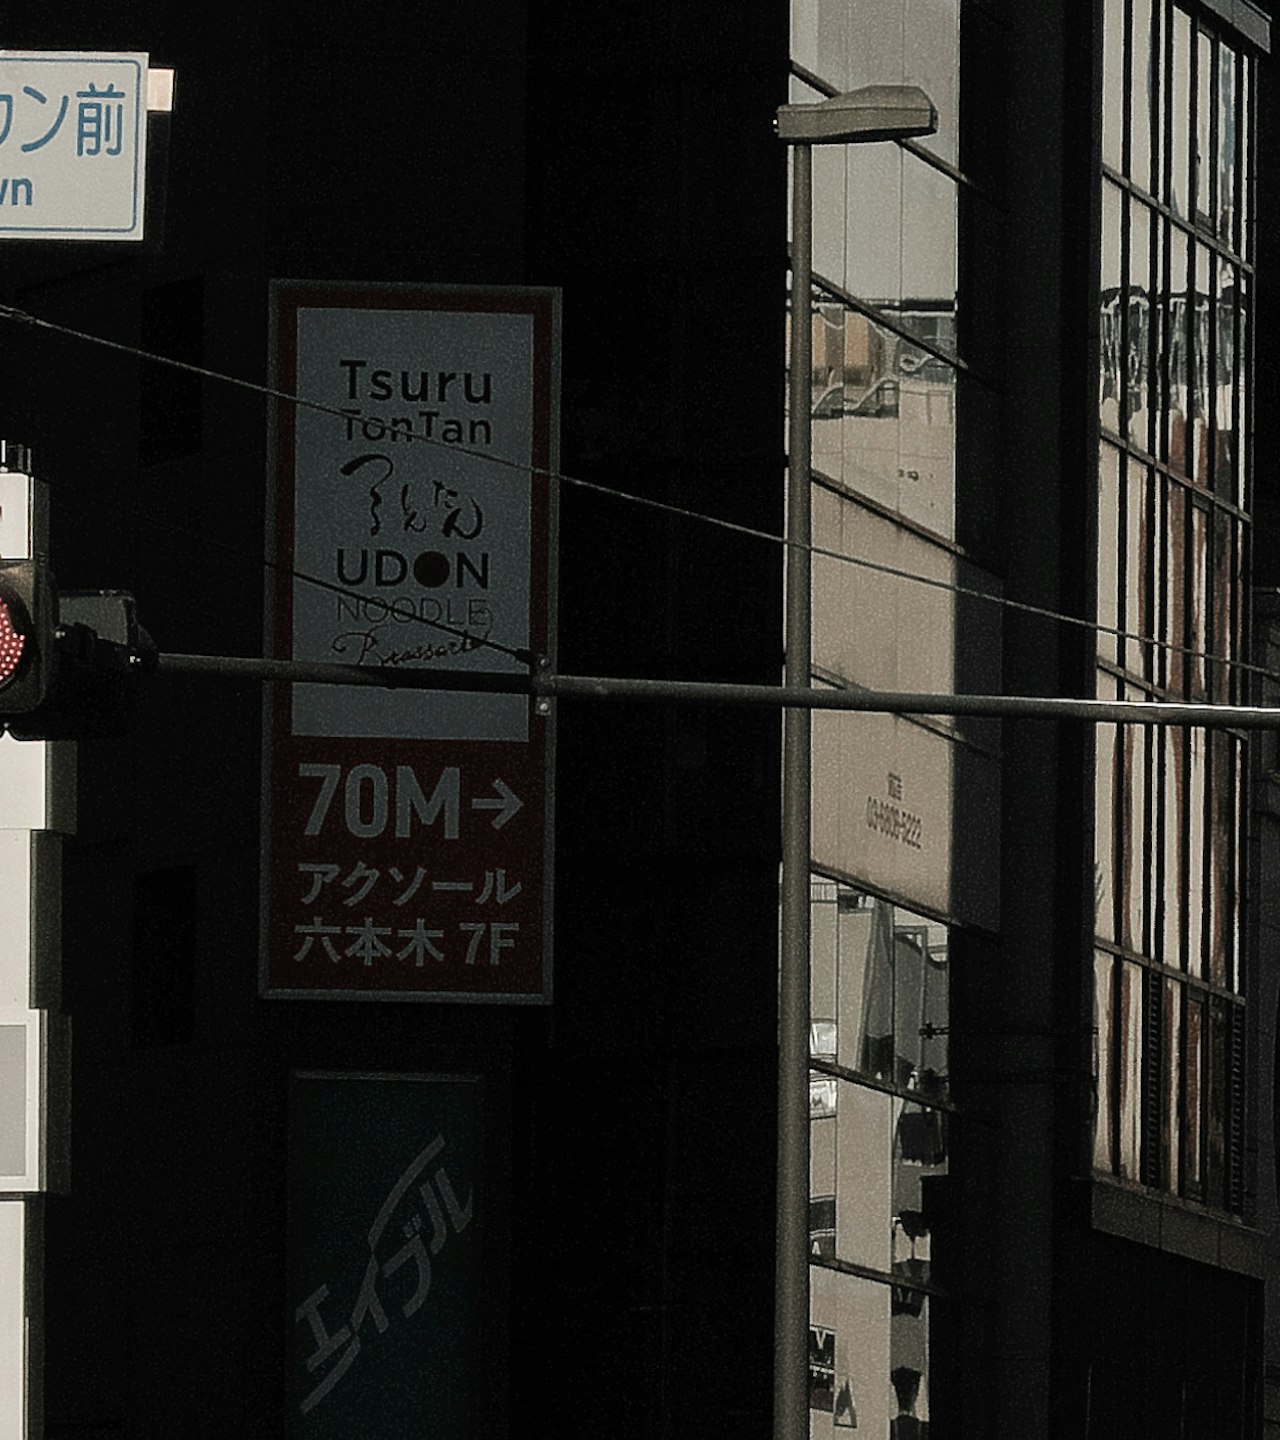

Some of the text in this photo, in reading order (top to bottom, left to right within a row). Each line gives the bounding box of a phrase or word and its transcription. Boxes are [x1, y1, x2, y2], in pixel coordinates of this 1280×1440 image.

[340, 359, 493, 402] Tsuru
[342, 410, 492, 445] TonTan
[336, 549, 489, 590] UDON
[336, 596, 488, 626] NOODLE
[298, 762, 461, 840] 70M
[297, 861, 522, 907] アクソール
[293, 920, 520, 966] 六本木 7F
[296, 1135, 474, 1414] エイブル
